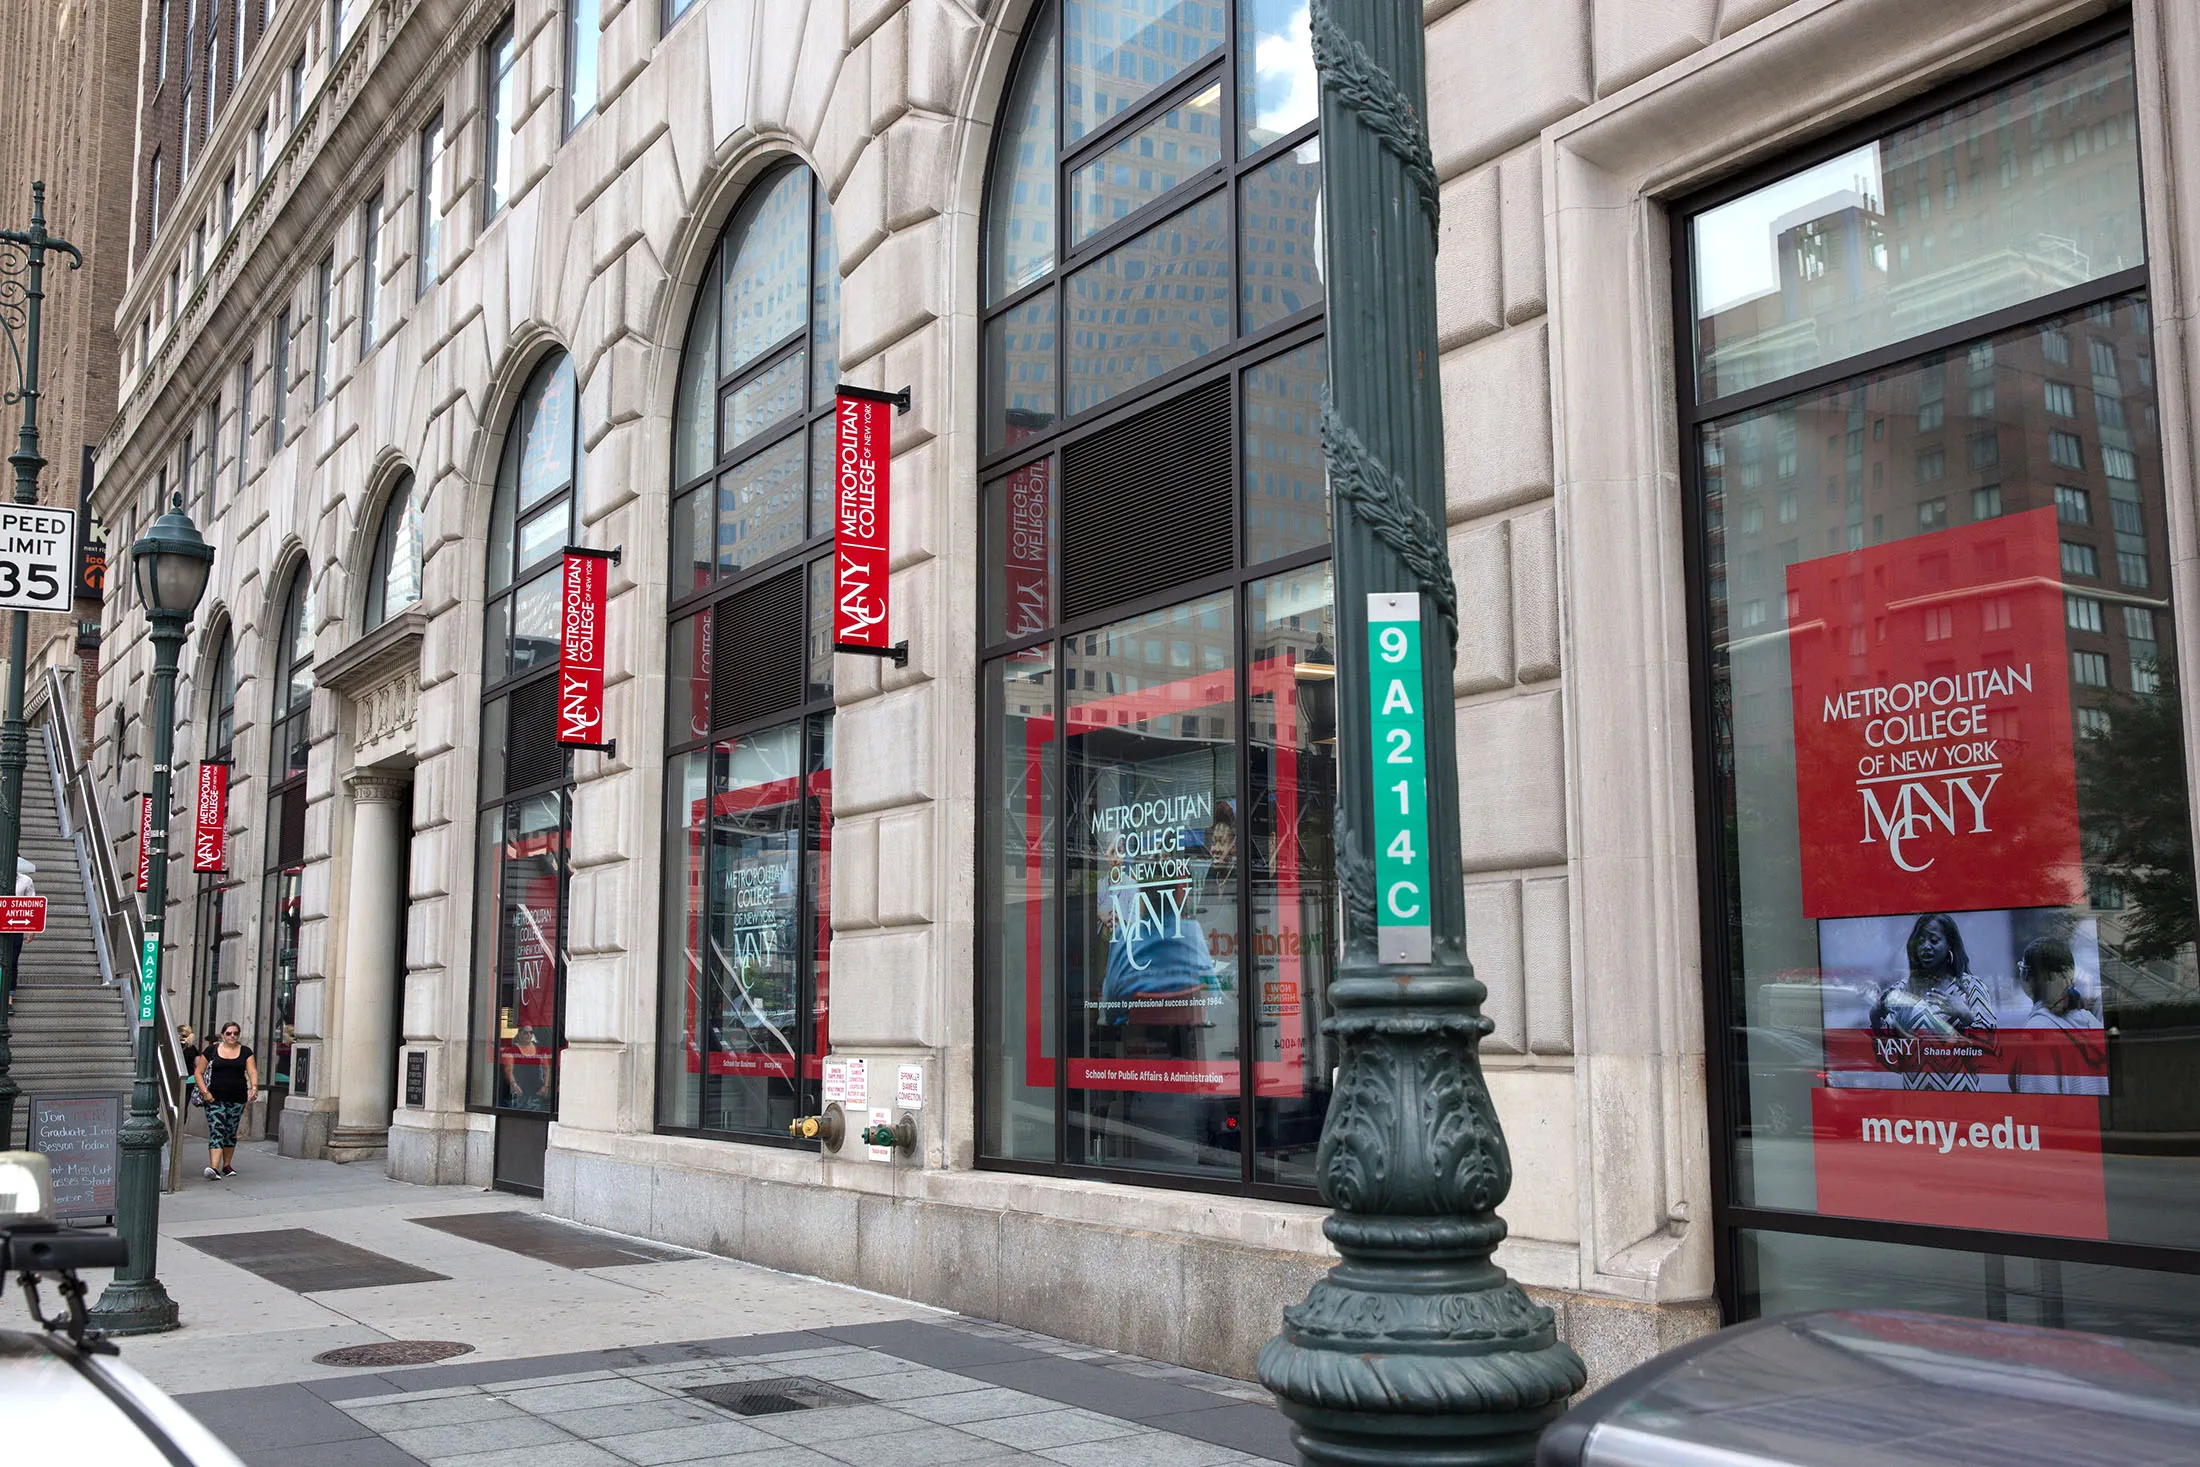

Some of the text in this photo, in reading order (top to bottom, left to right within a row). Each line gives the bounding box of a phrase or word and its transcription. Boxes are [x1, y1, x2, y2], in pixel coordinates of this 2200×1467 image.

[841, 400, 859, 537] METROPOLITAN
[864, 448, 871, 459] OF
[859, 460, 875, 539] COLLEGE
[3, 514, 66, 535] PEED
[85, 554, 105, 564] ico
[0, 560, 60, 601] 35
[565, 557, 582, 662] METROPOLITAN
[580, 601, 595, 663] COLLEGE
[1823, 663, 2033, 723] METROPOLITAN
[1864, 703, 1988, 748] COLLEGE
[1379, 627, 1420, 919] 9A214C
[1858, 739, 1999, 777] OF NEW YORK
[200, 765, 212, 825] METROPOLITAN
[208, 790, 219, 825] COLLEGE
[1091, 791, 1213, 834] METROPOLITAN
[1115, 825, 1186, 859] COLLEGE
[725, 860, 789, 889] METROPOLITAN
[1110, 857, 1192, 884] OF NEW YORK
[6, 909, 35, 917] ANYTIME
[11, 899, 44, 908] STANDING
[737, 886, 774, 908] COLLEGE
[142, 942, 155, 1018] 9A2W8B
[1084, 1000, 1098, 1009] From
[1098, 1000, 1121, 1010] purpose
[1121, 1000, 1128, 1008] to
[1128, 998, 1164, 1010] professional
[1164, 999, 1189, 1008] success
[1189, 998, 1206, 1007] since
[1924, 1047, 1951, 1057] Shana
[1953, 1047, 1983, 1057] Melius
[1085, 1069, 1224, 1084] School for Public Affairs & Administration
[40, 1110, 65, 1123] Join
[40, 1126, 87, 1138] Graduate
[38, 1140, 74, 1153] Session
[1861, 1115, 2041, 1155] mcny.edu
